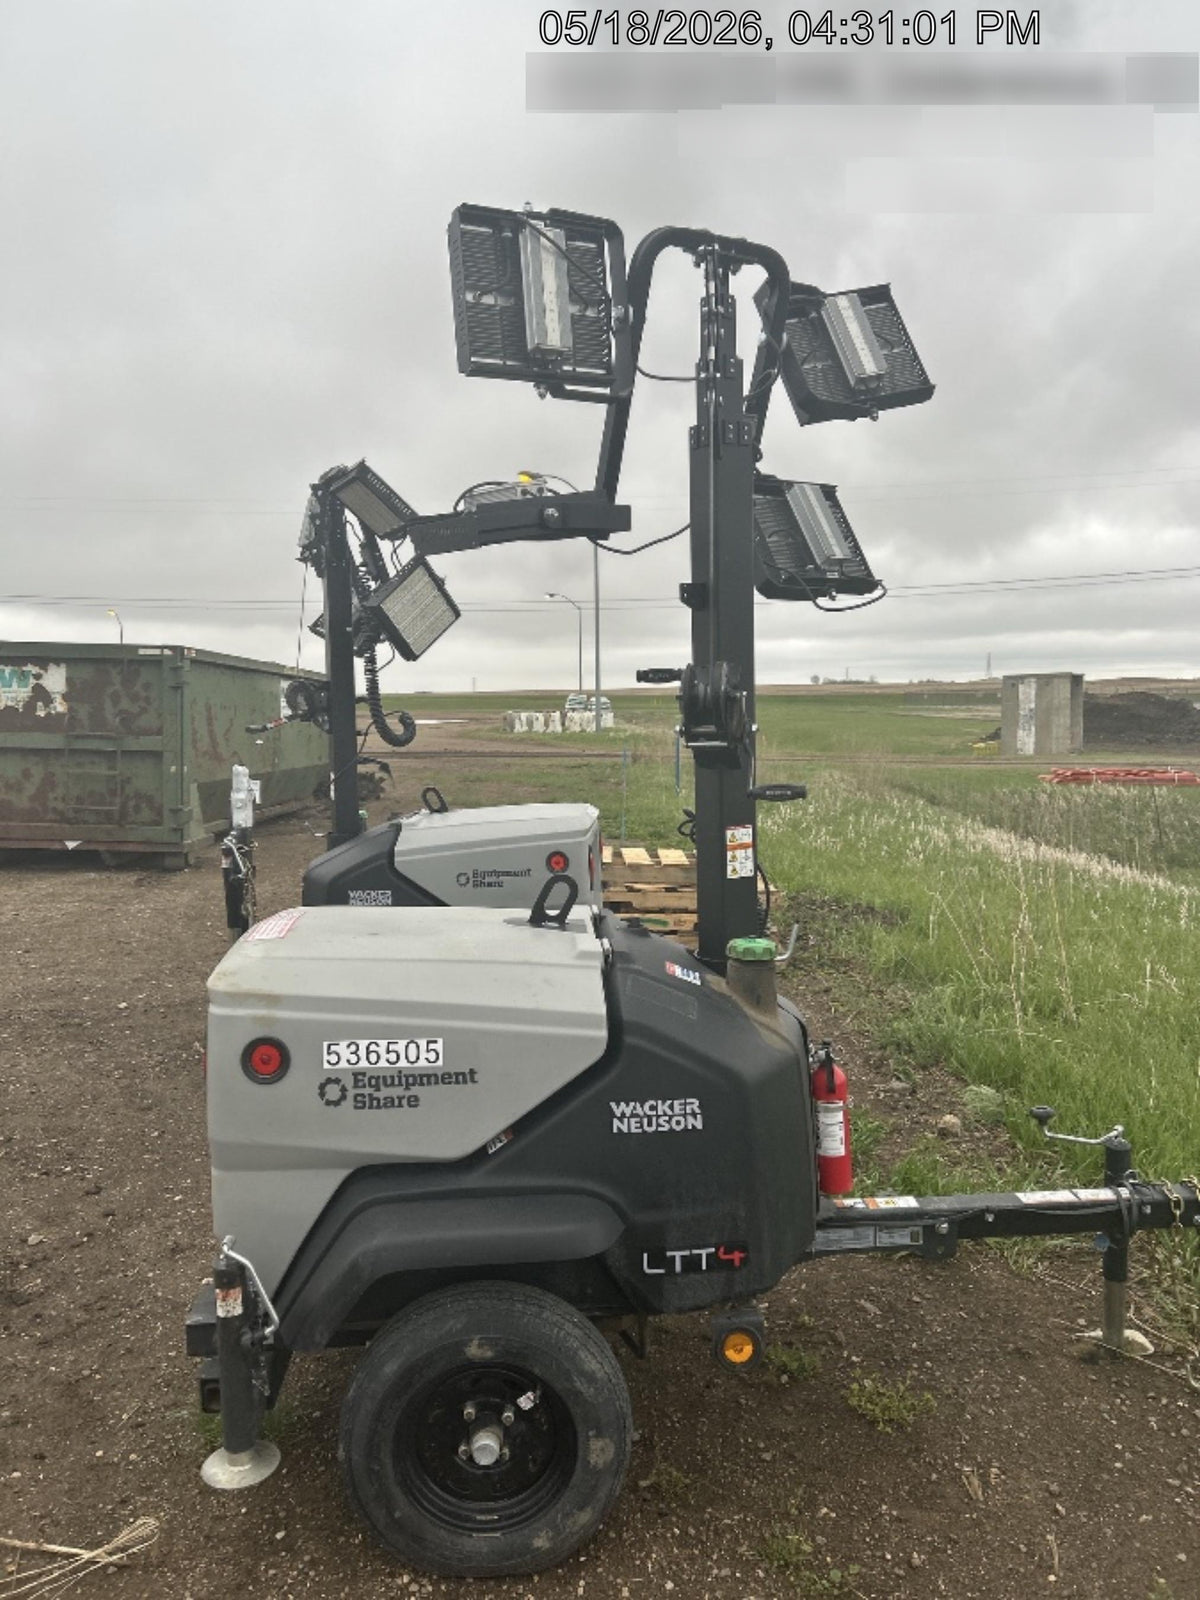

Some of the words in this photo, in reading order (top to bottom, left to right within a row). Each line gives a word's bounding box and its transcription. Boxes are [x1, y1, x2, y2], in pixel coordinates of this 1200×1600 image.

[472, 868, 532, 881] Equipment
[472, 880, 504, 888] Share
[348, 890, 392, 899] WACKER
[326, 1039, 440, 1067] 536505
[352, 1068, 479, 1092] Equipment
[353, 1092, 421, 1110] Share
[610, 1098, 702, 1117] WACKER
[612, 1115, 704, 1134] NEUSON
[643, 1246, 747, 1274] LTT4
